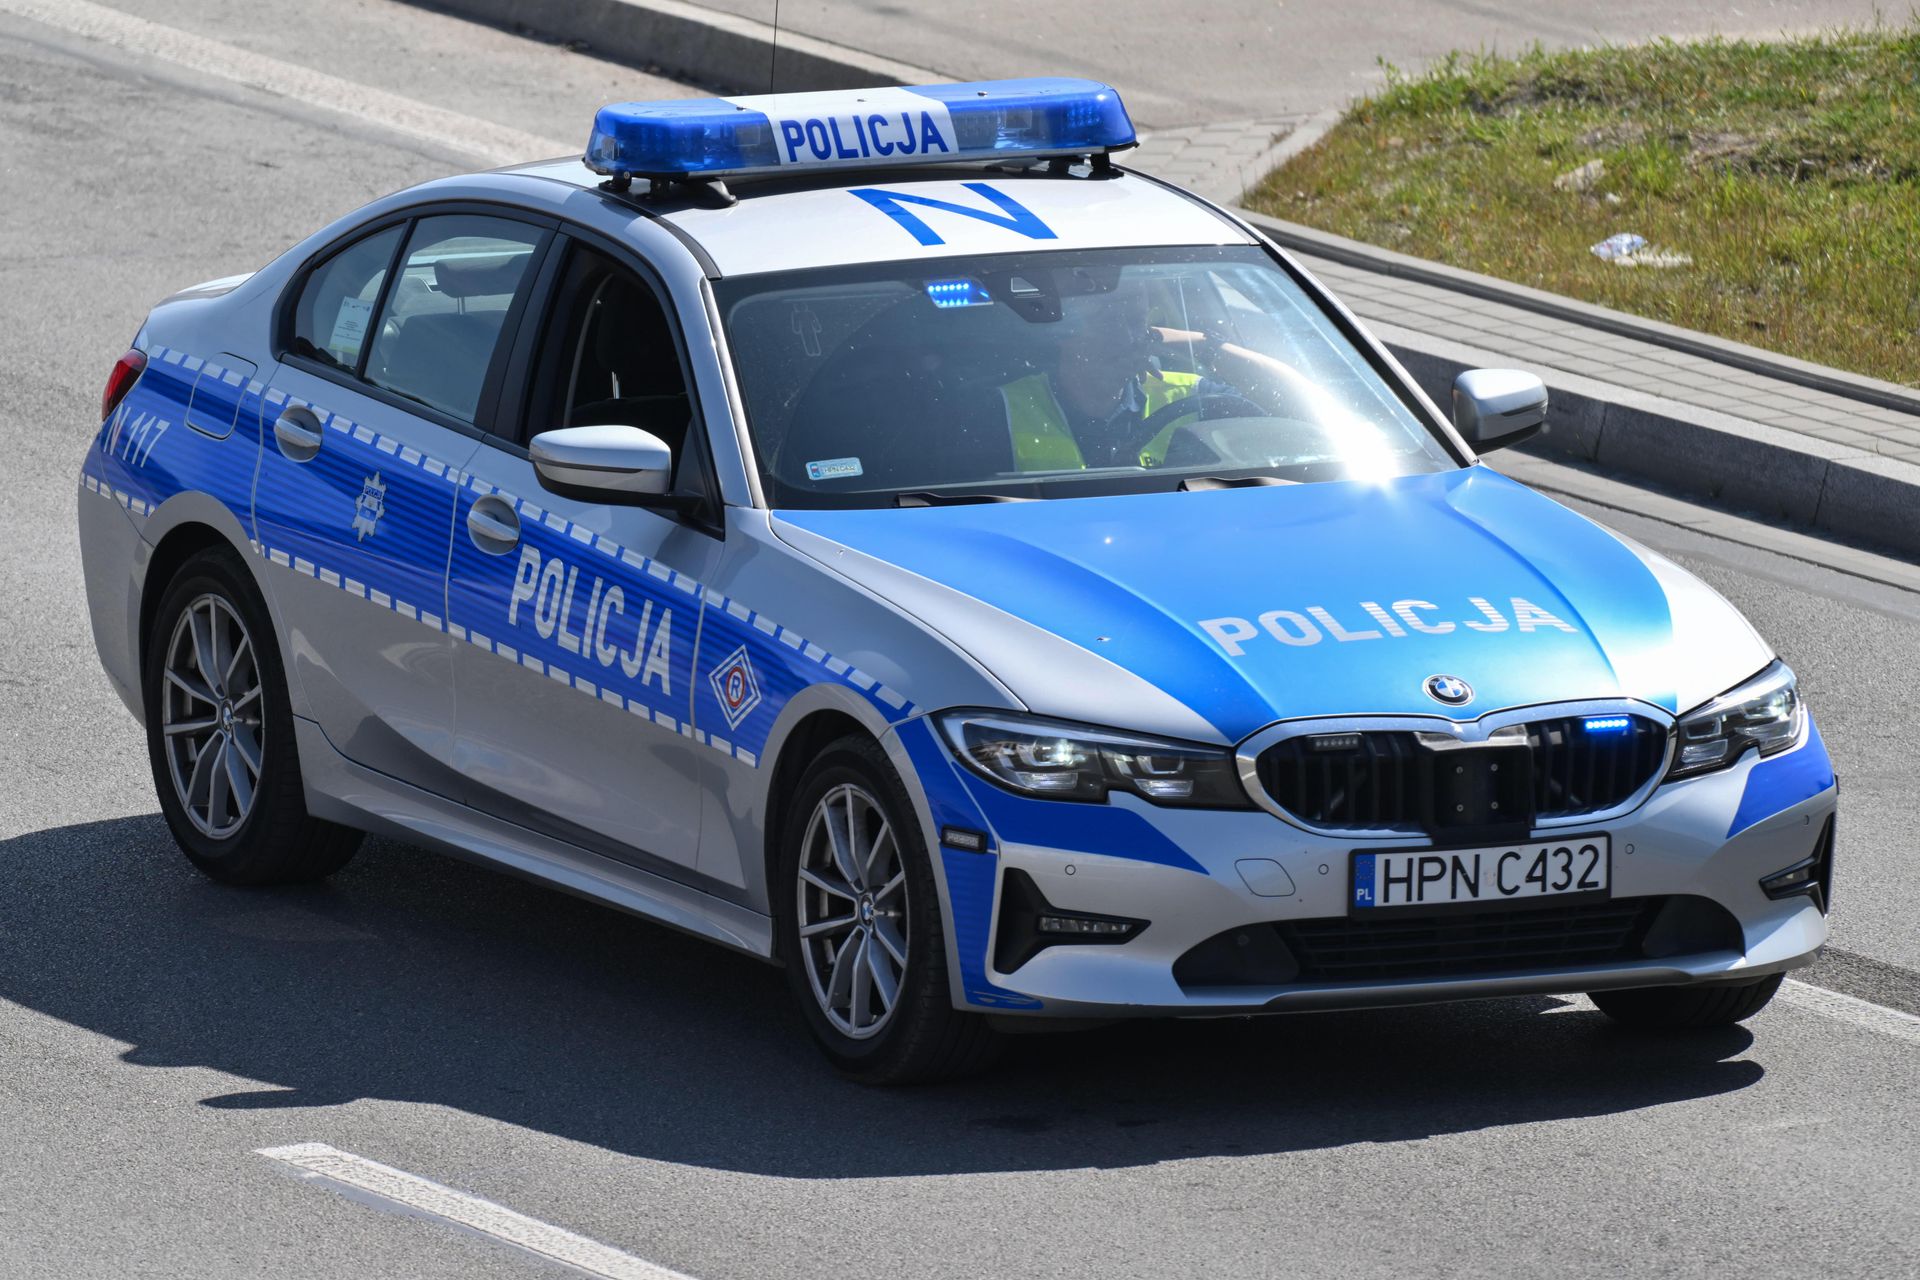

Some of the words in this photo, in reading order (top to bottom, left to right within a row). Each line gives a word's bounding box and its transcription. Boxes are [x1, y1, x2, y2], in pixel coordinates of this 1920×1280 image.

[779, 111, 949, 162] POLICJA
[847, 182, 1058, 246] N
[103, 403, 131, 456] N
[122, 411, 171, 468] 117
[508, 543, 672, 696] POLICJA
[1197, 597, 1579, 656] POLICJA
[731, 675, 740, 699] R
[1357, 888, 1372, 901] PL
[1382, 853, 1481, 903] HPN
[1496, 844, 1600, 896] C432
